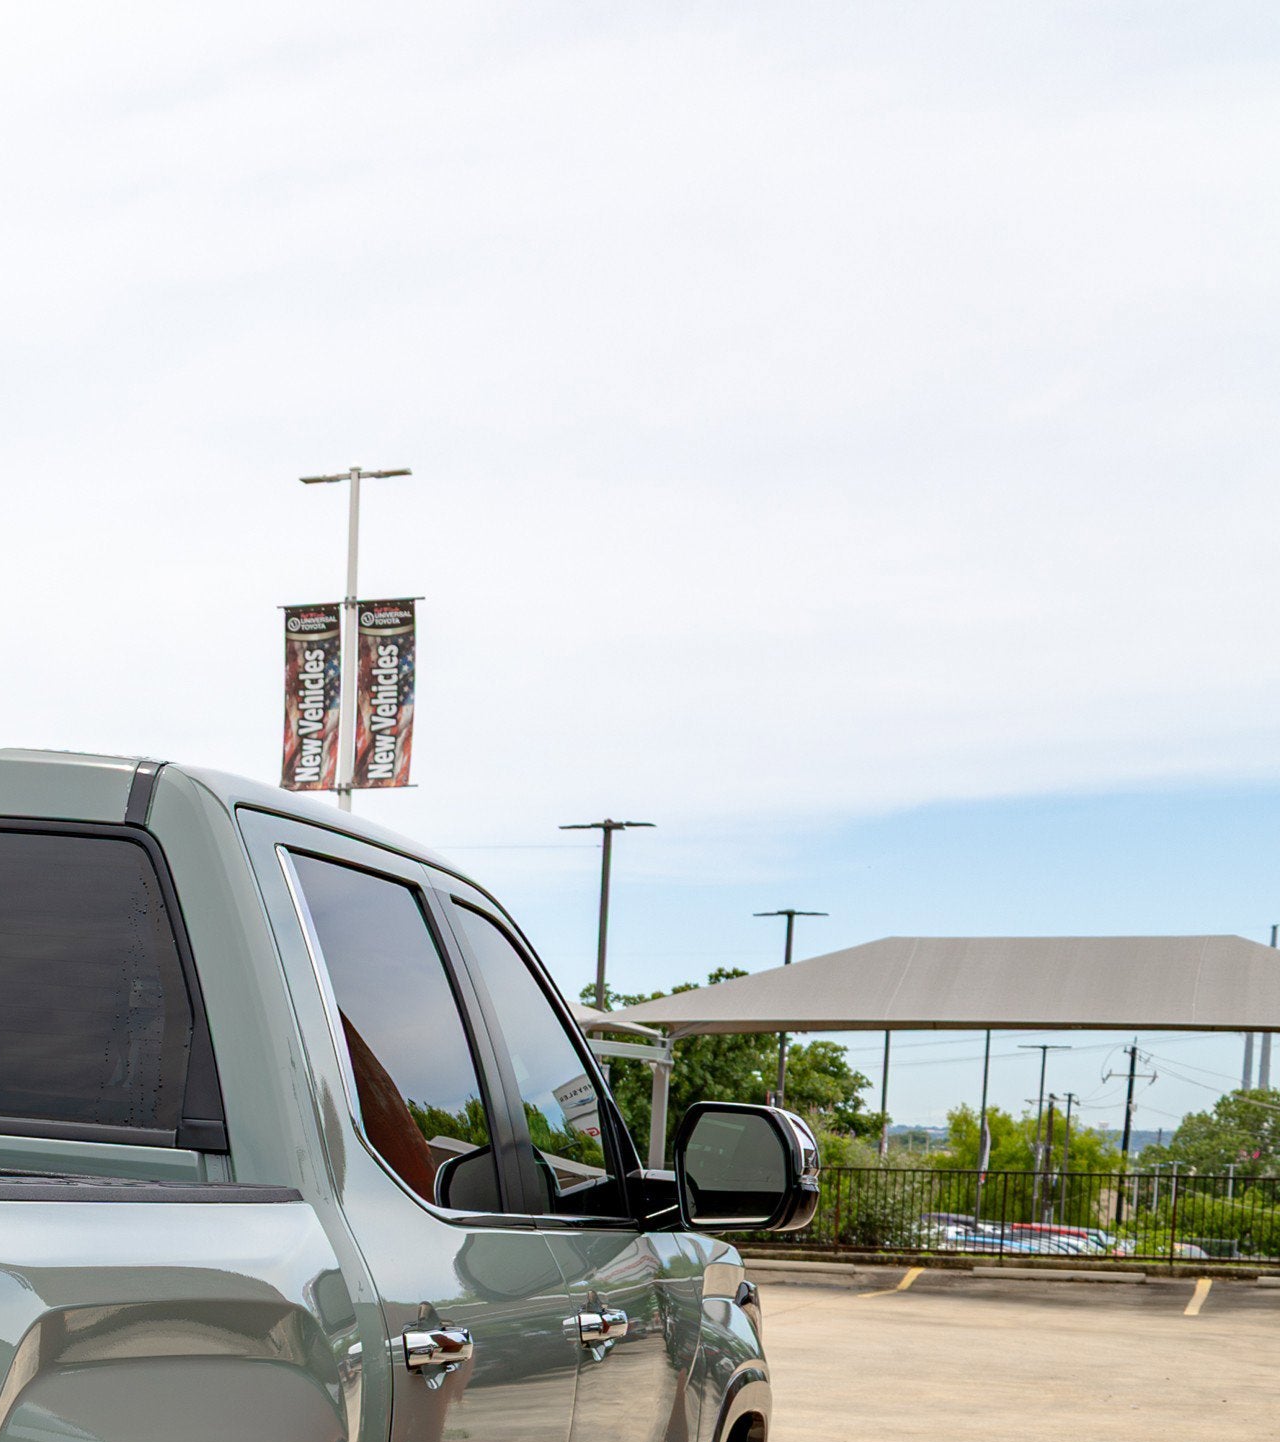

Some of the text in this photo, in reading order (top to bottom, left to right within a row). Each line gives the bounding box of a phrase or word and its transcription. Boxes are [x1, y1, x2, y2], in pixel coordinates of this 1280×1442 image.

[298, 649, 325, 736] Vehicles
[371, 644, 399, 731] Vehicles
[295, 738, 322, 782] New
[368, 735, 397, 779] New
